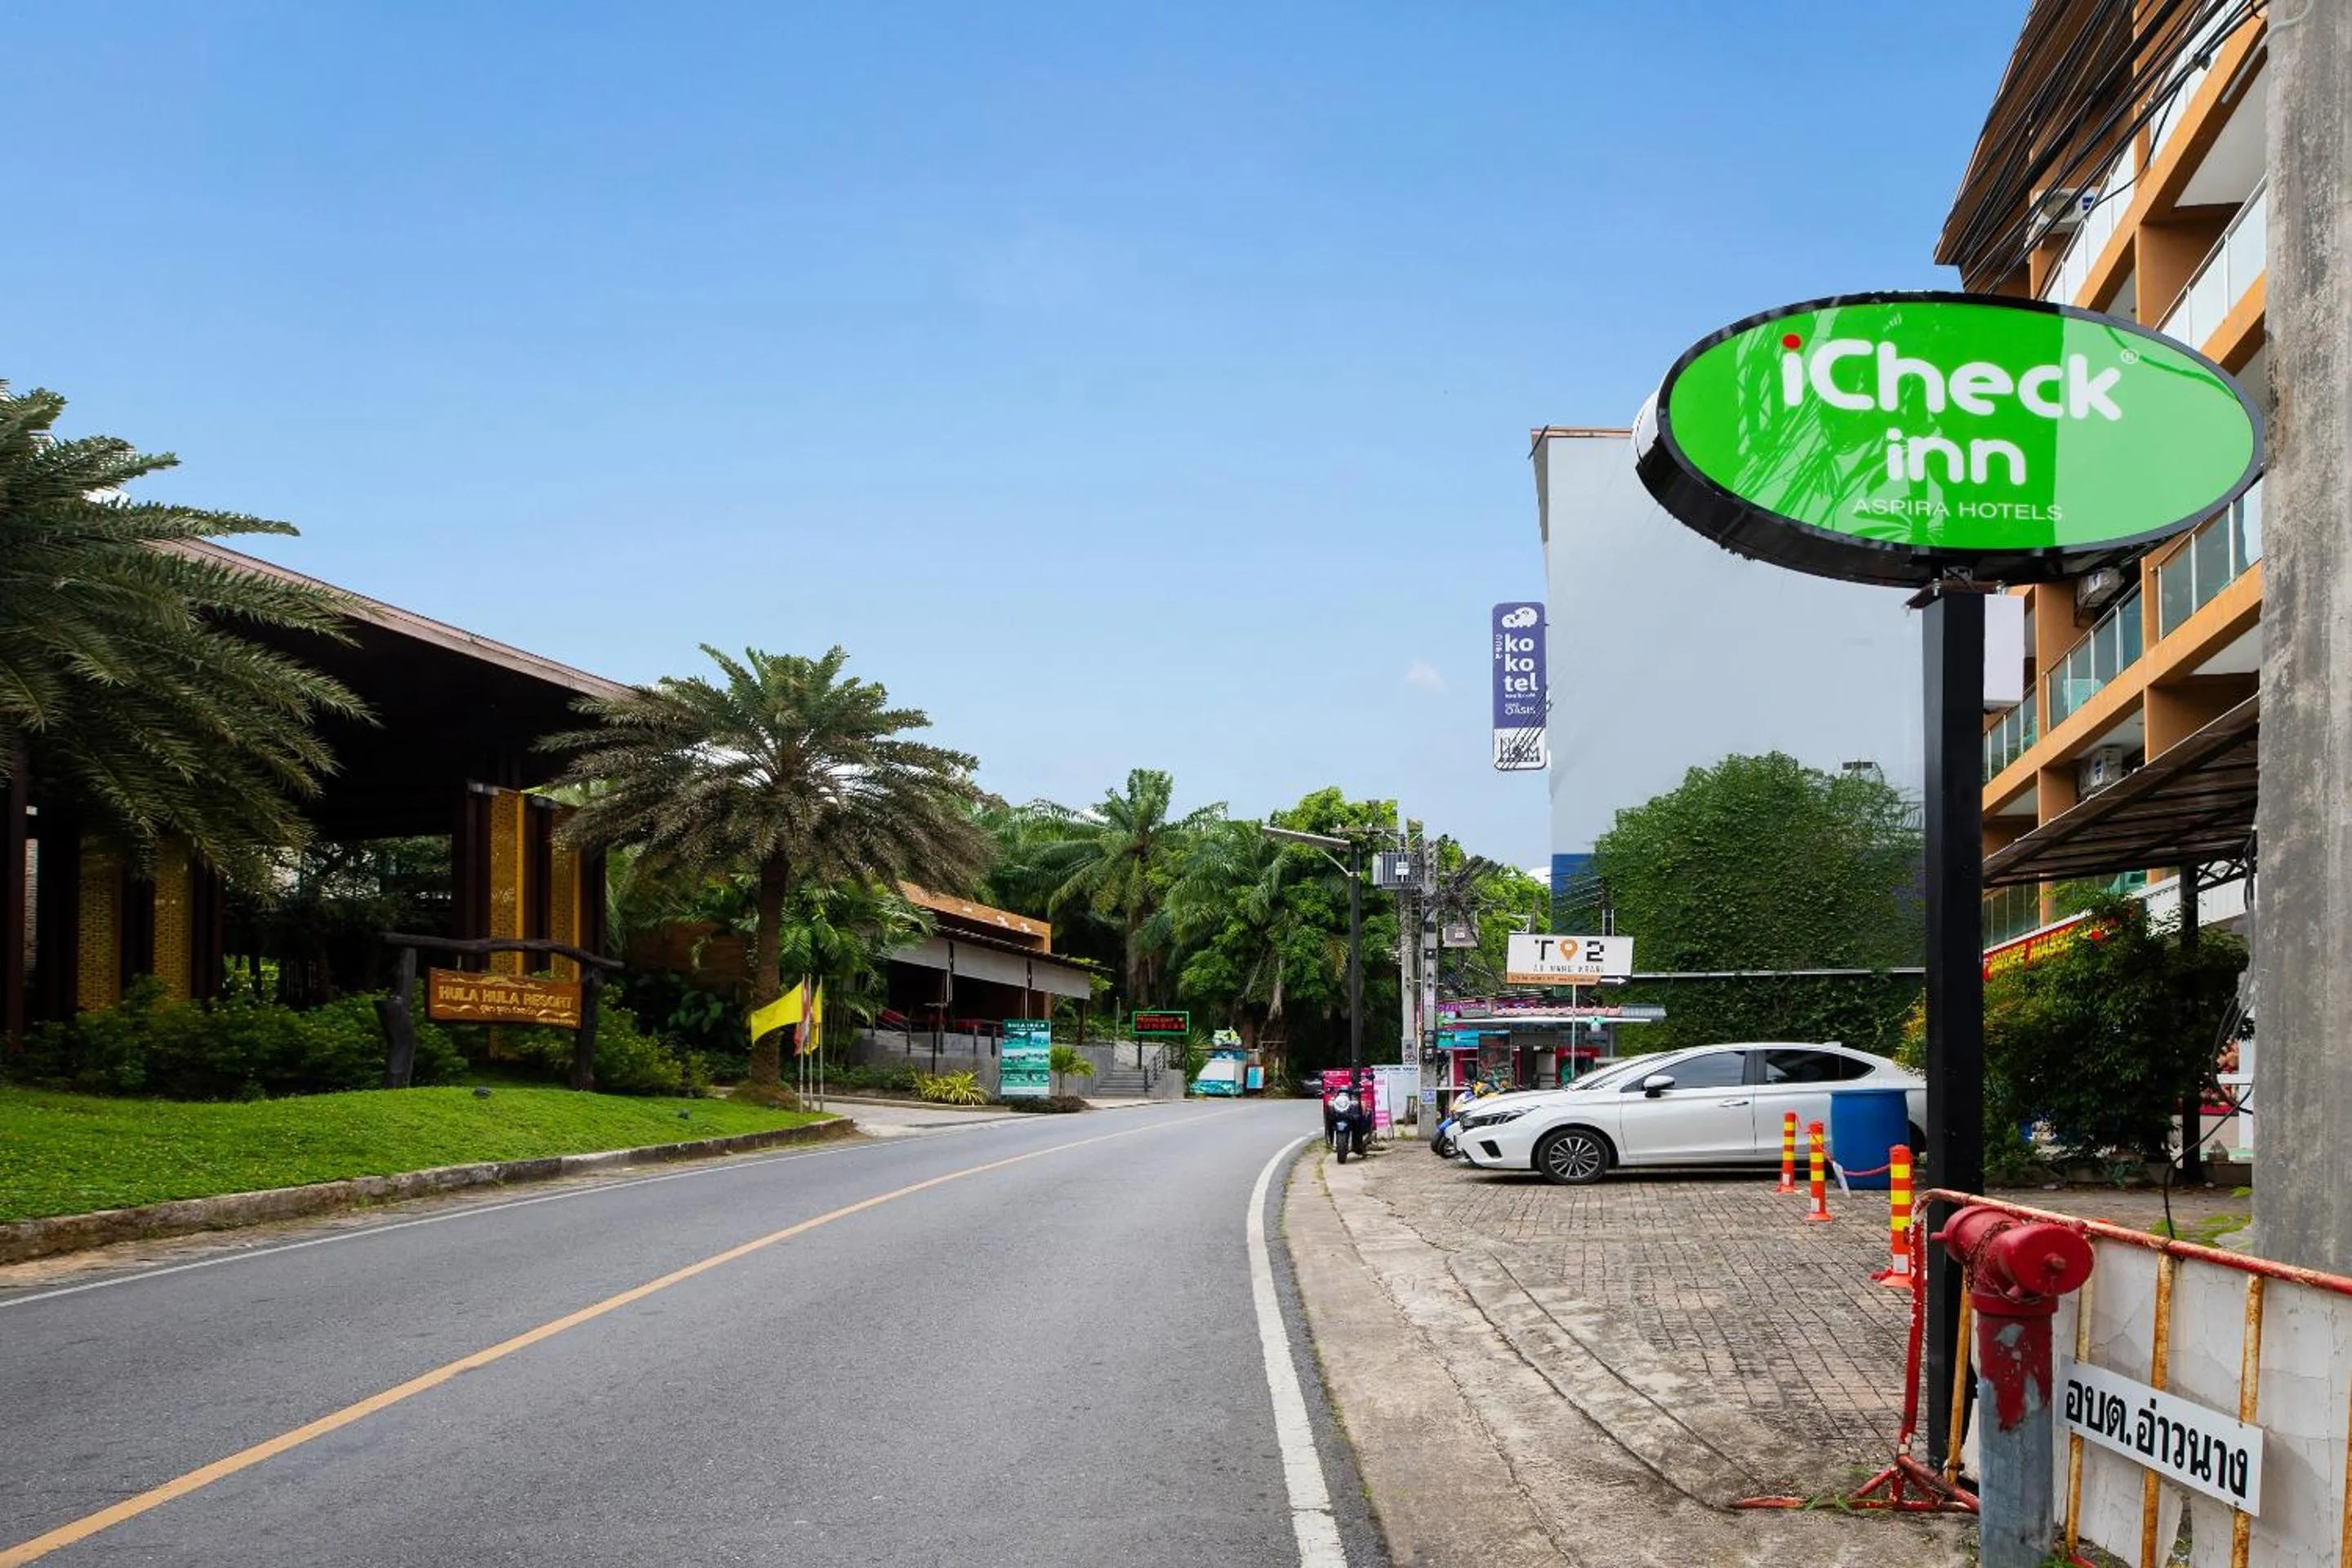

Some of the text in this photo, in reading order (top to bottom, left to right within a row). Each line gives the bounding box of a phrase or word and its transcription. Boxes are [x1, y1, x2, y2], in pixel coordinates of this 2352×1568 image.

[1781, 333, 2123, 421] iCheck
[1886, 428, 2026, 485] inn
[1852, 497, 2063, 522] ASPIRA HOTELS
[1504, 633, 1535, 653] ko
[1504, 653, 1535, 672] ko
[1503, 672, 1539, 692] tel
[439, 986, 573, 1009] HULA HULA RESORT
[2065, 1379, 2247, 1499] อบต.อ่าวนาง
